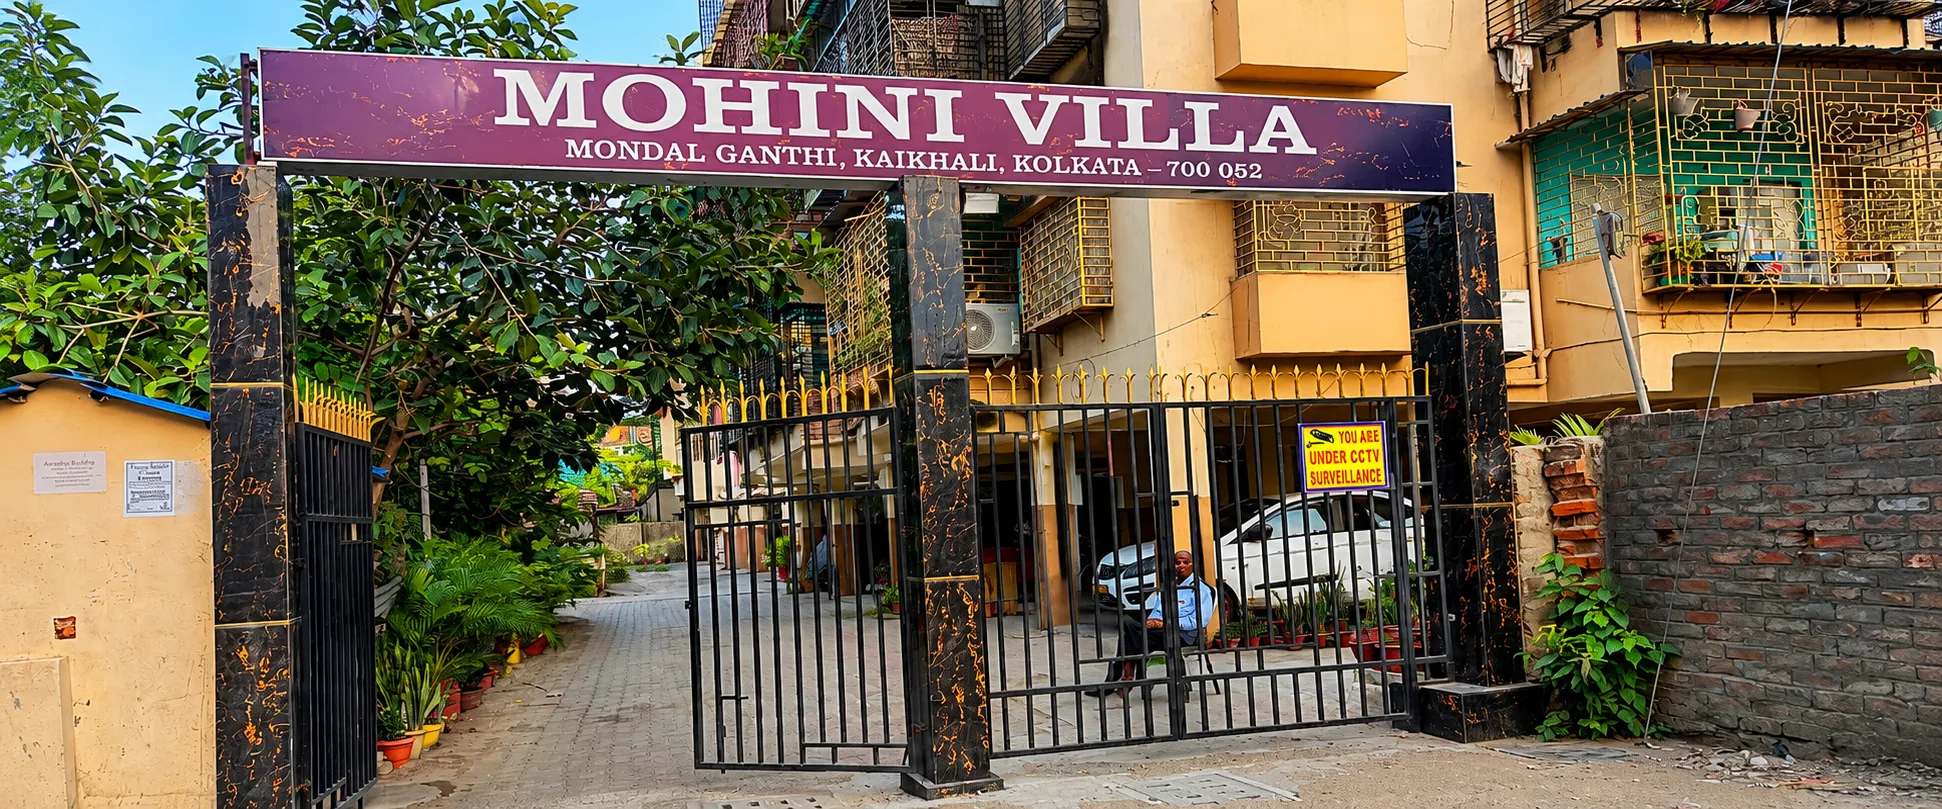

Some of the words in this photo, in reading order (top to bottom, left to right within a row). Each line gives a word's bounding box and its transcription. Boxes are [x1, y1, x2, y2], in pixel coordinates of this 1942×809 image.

[493, 68, 965, 143] MOHINI
[994, 91, 1318, 155] VILLA
[564, 138, 706, 163] MONDAL
[715, 144, 846, 171] GANTHI,
[853, 148, 1006, 175] KAIKHALI,
[1012, 154, 1142, 177] KOLKATA
[1166, 160, 1211, 178] 700
[1218, 162, 1263, 180] 052
[1338, 430, 1358, 444] YOU
[1309, 450, 1347, 465] UNDER
[1350, 449, 1380, 463] CCTV
[1310, 468, 1382, 486] SURVEILLANCE
